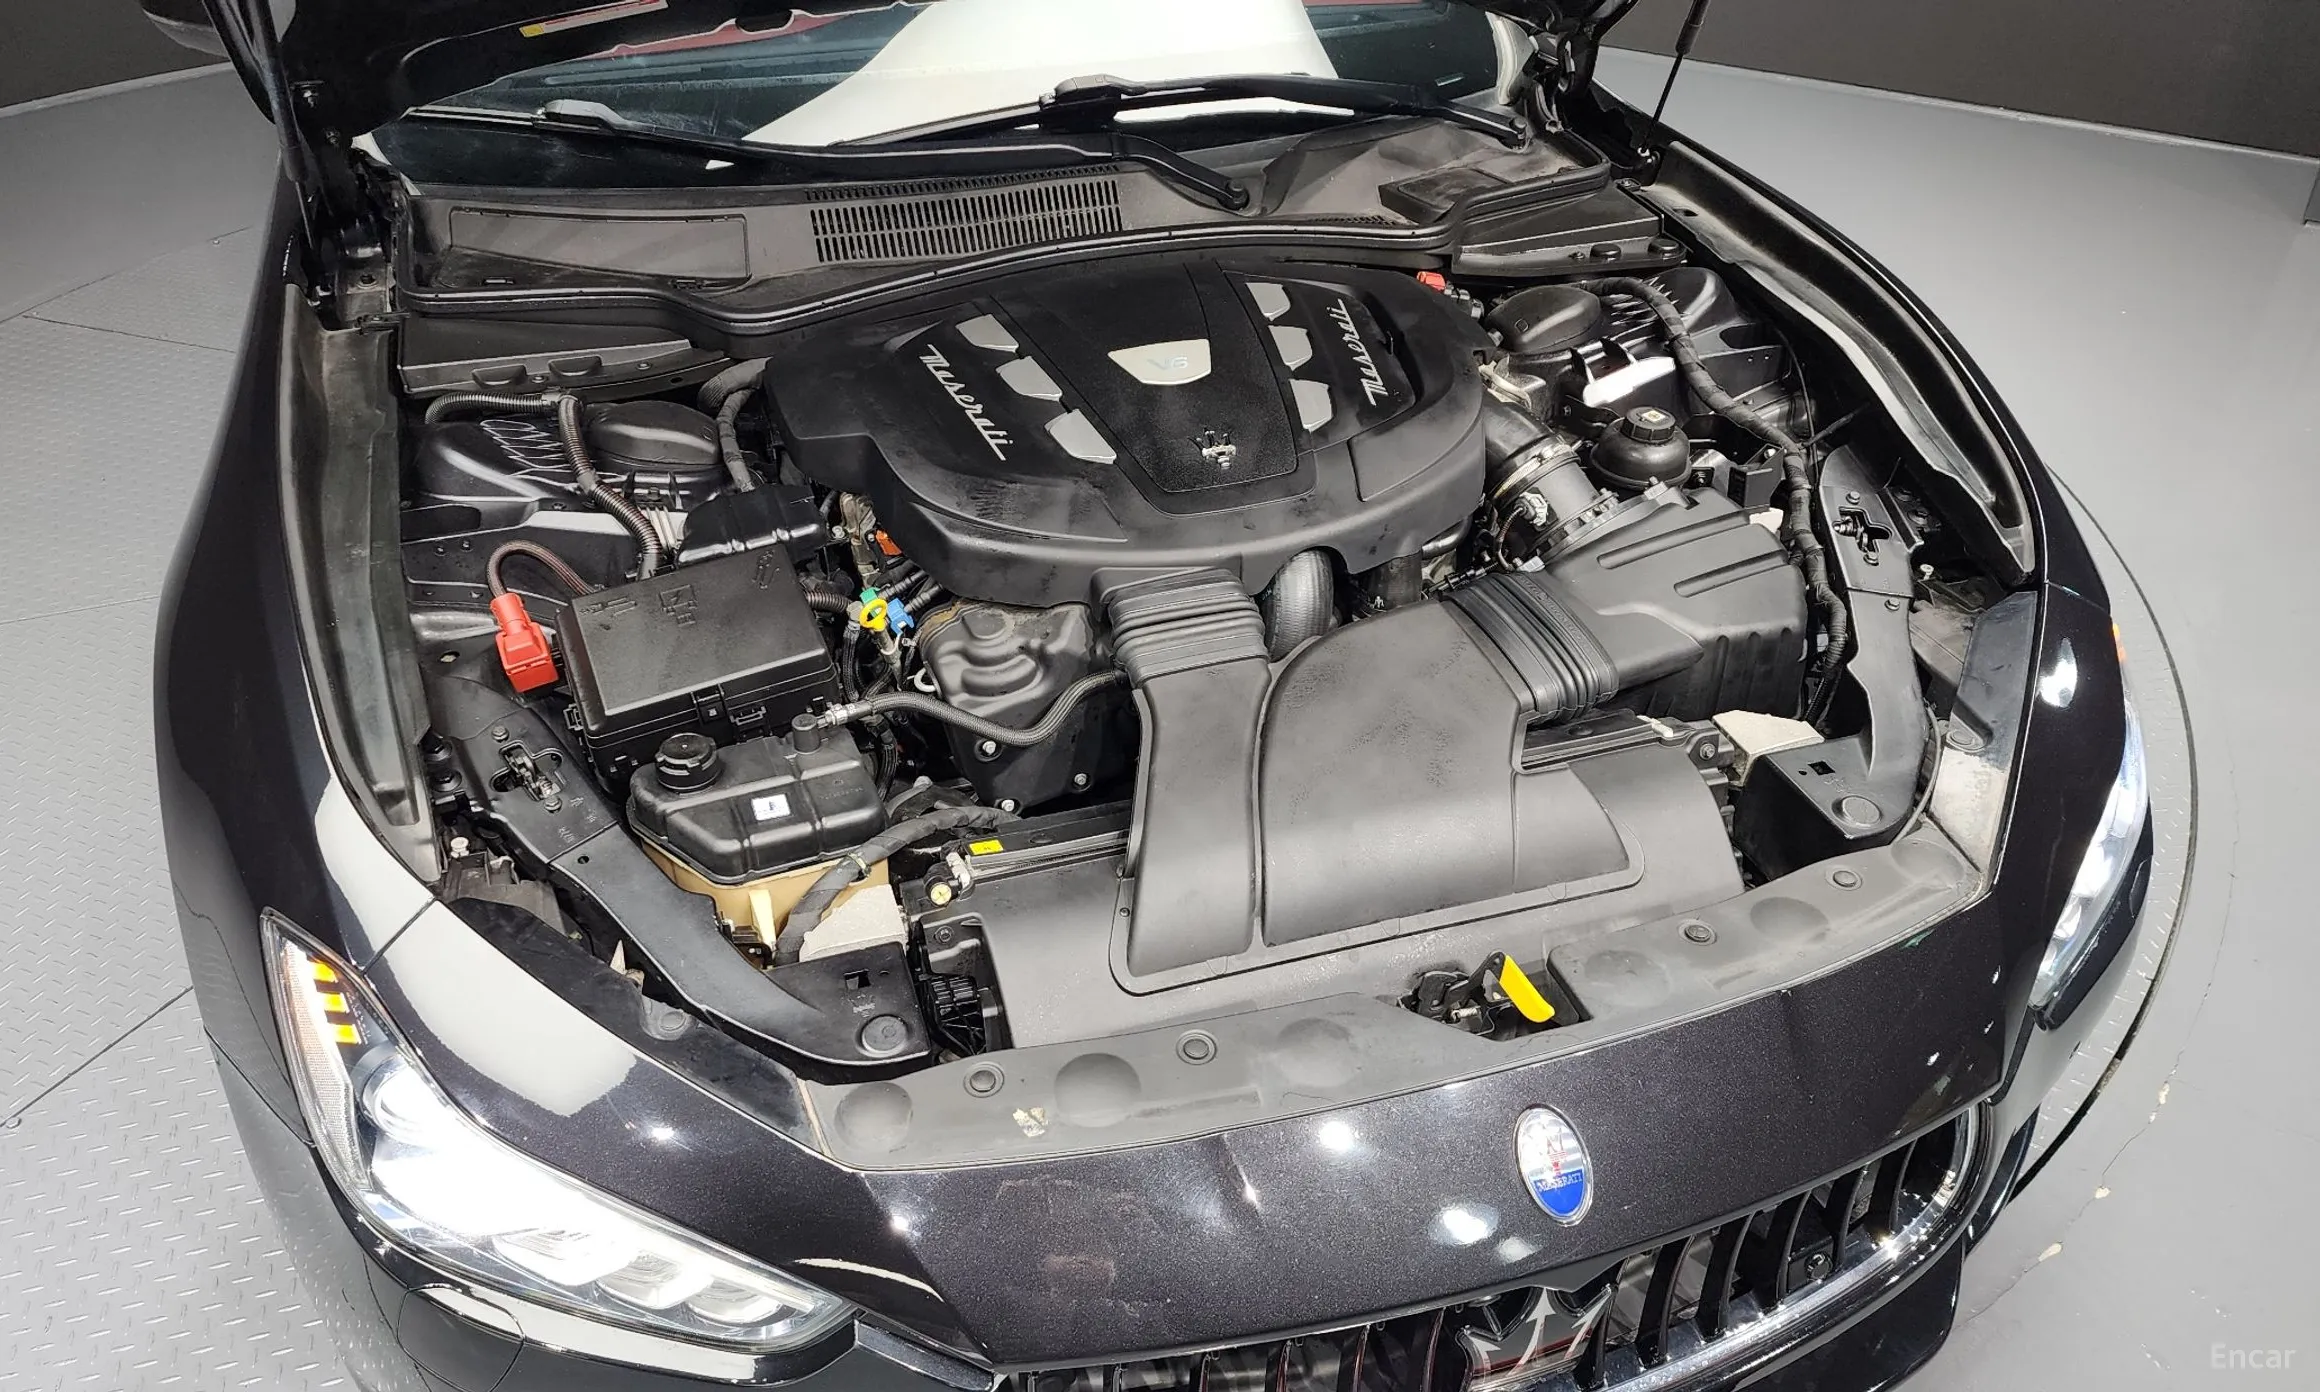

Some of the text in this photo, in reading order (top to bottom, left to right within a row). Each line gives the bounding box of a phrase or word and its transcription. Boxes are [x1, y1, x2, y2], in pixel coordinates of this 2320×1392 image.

[1147, 356, 1188, 370] V6
[1326, 298, 1389, 406] Maserati
[919, 344, 1014, 461] Maserati
[1536, 1172, 1582, 1191] MASERATI
